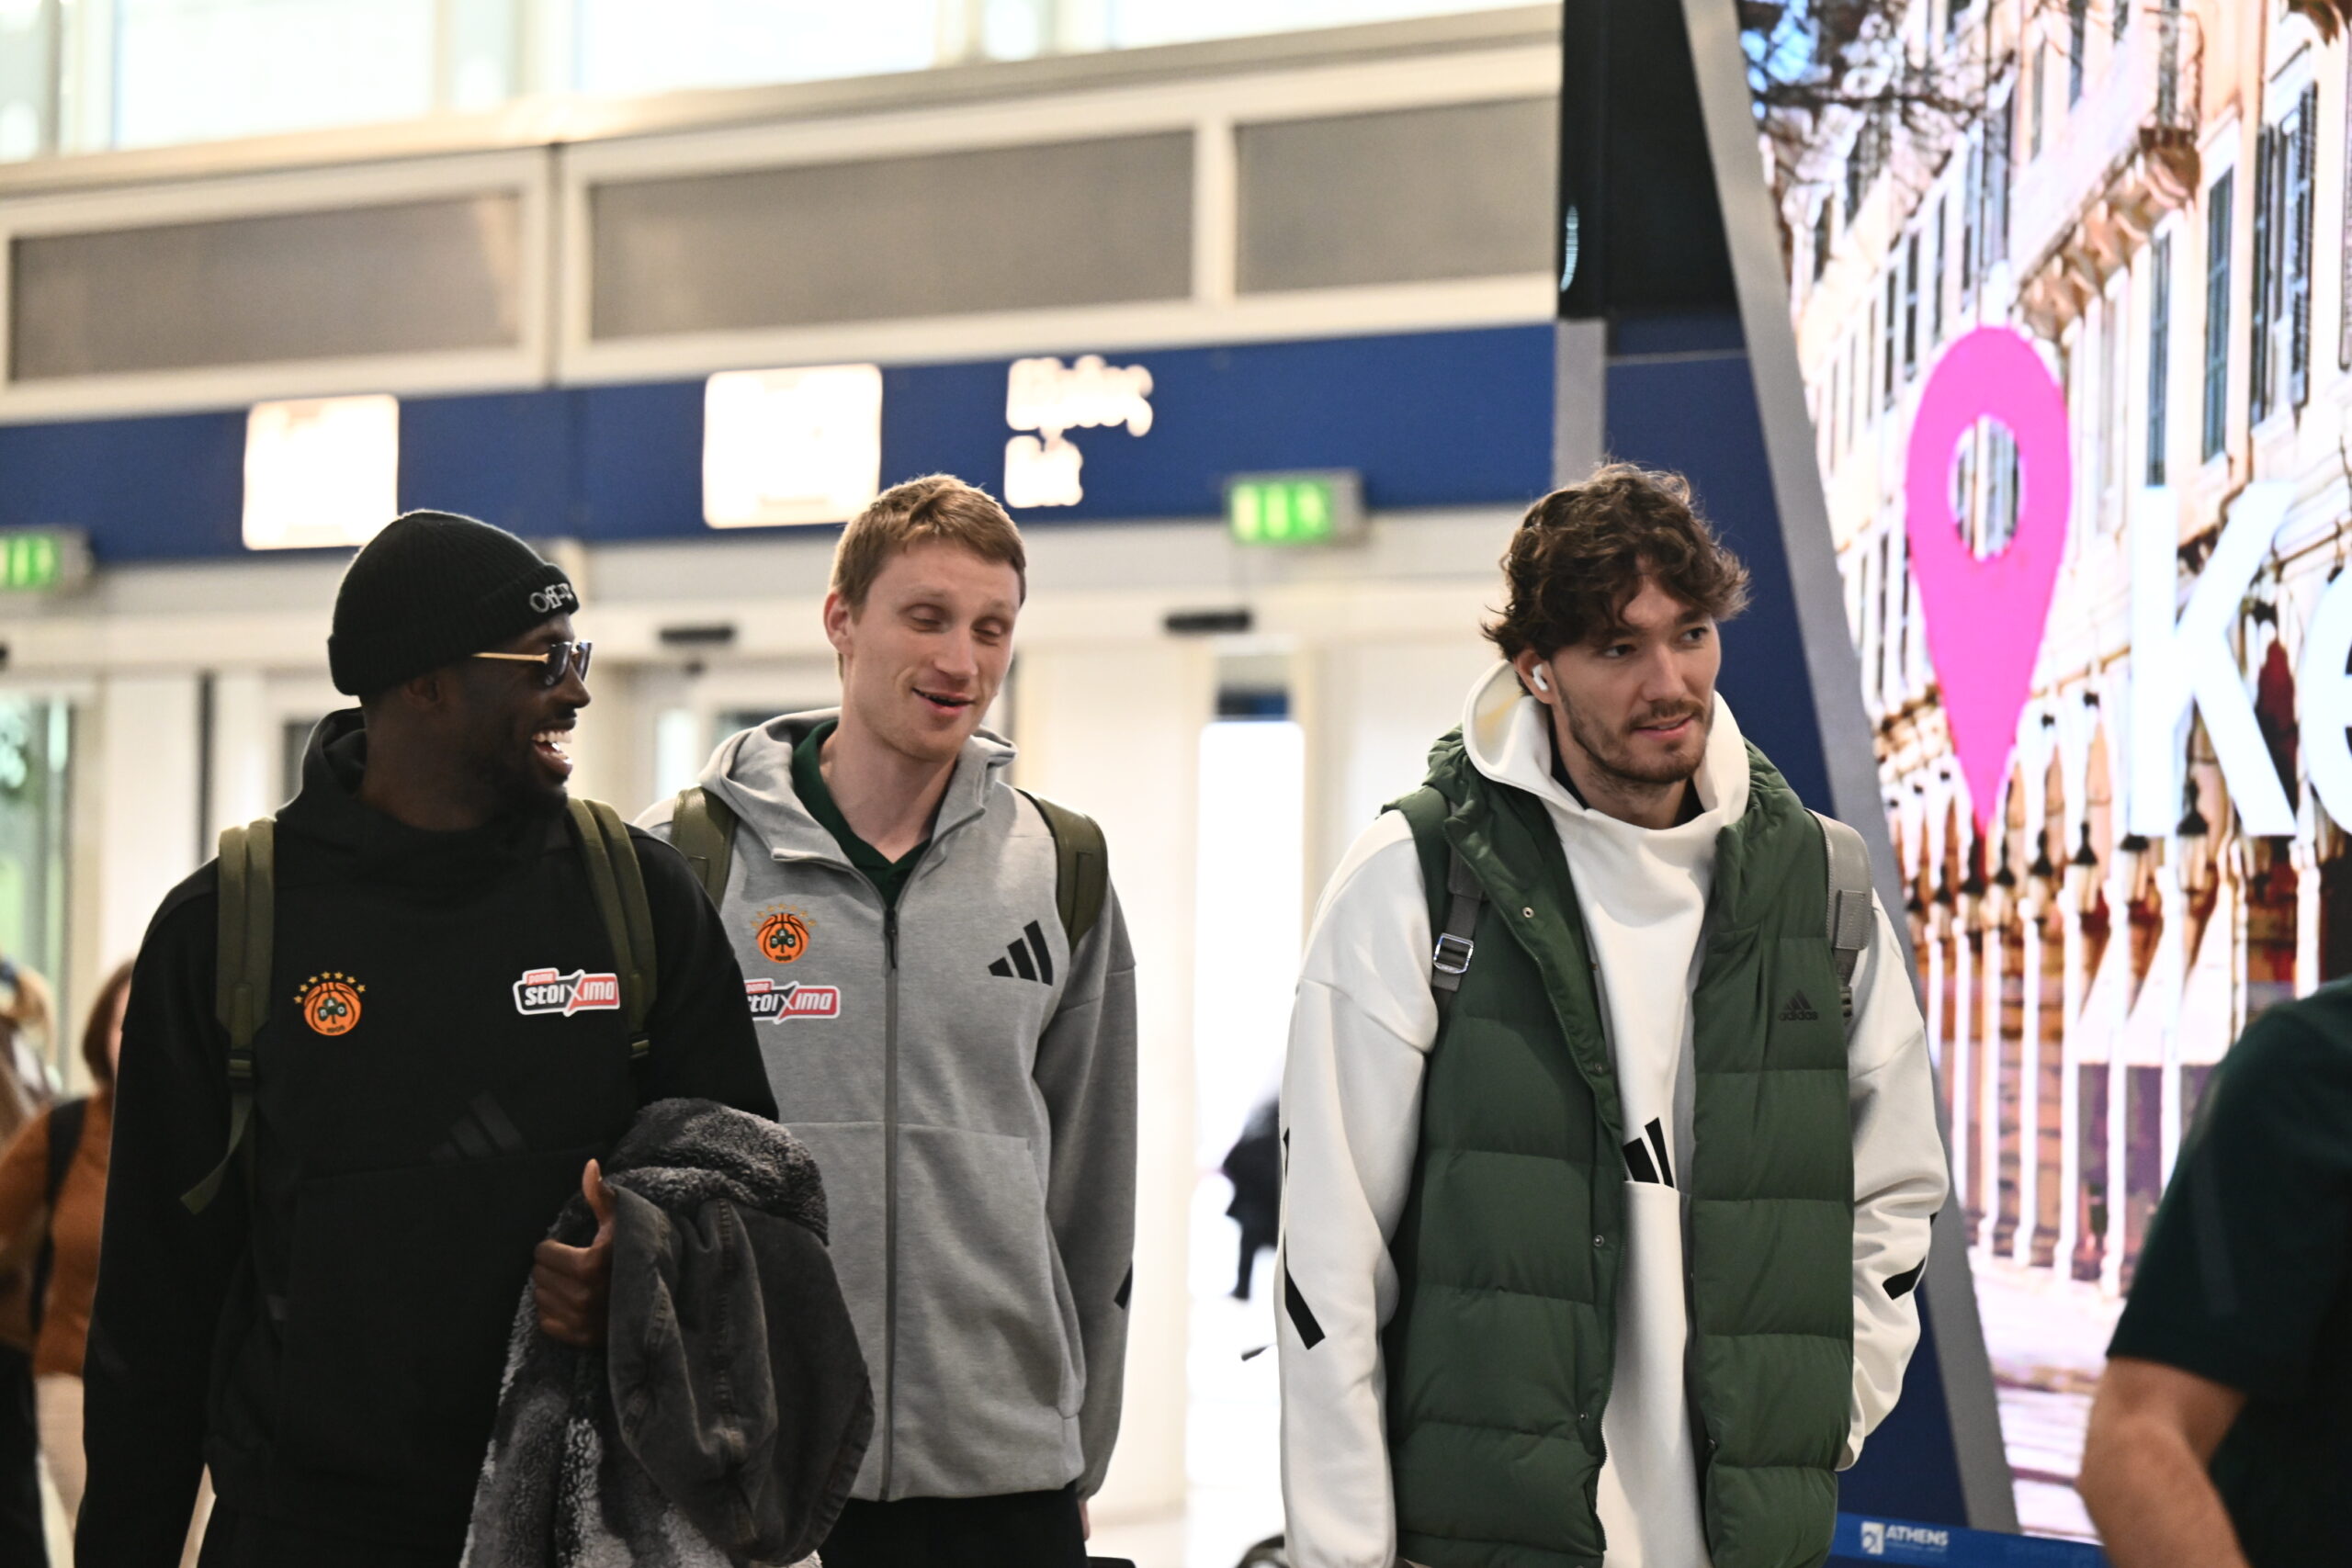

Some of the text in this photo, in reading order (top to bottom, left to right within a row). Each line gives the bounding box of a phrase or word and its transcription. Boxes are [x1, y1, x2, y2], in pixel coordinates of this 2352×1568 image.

[748, 988, 833, 1015] toiXima
[1779, 1011, 1818, 1021] adidas
[1885, 1525, 1949, 1547] ATHENS
